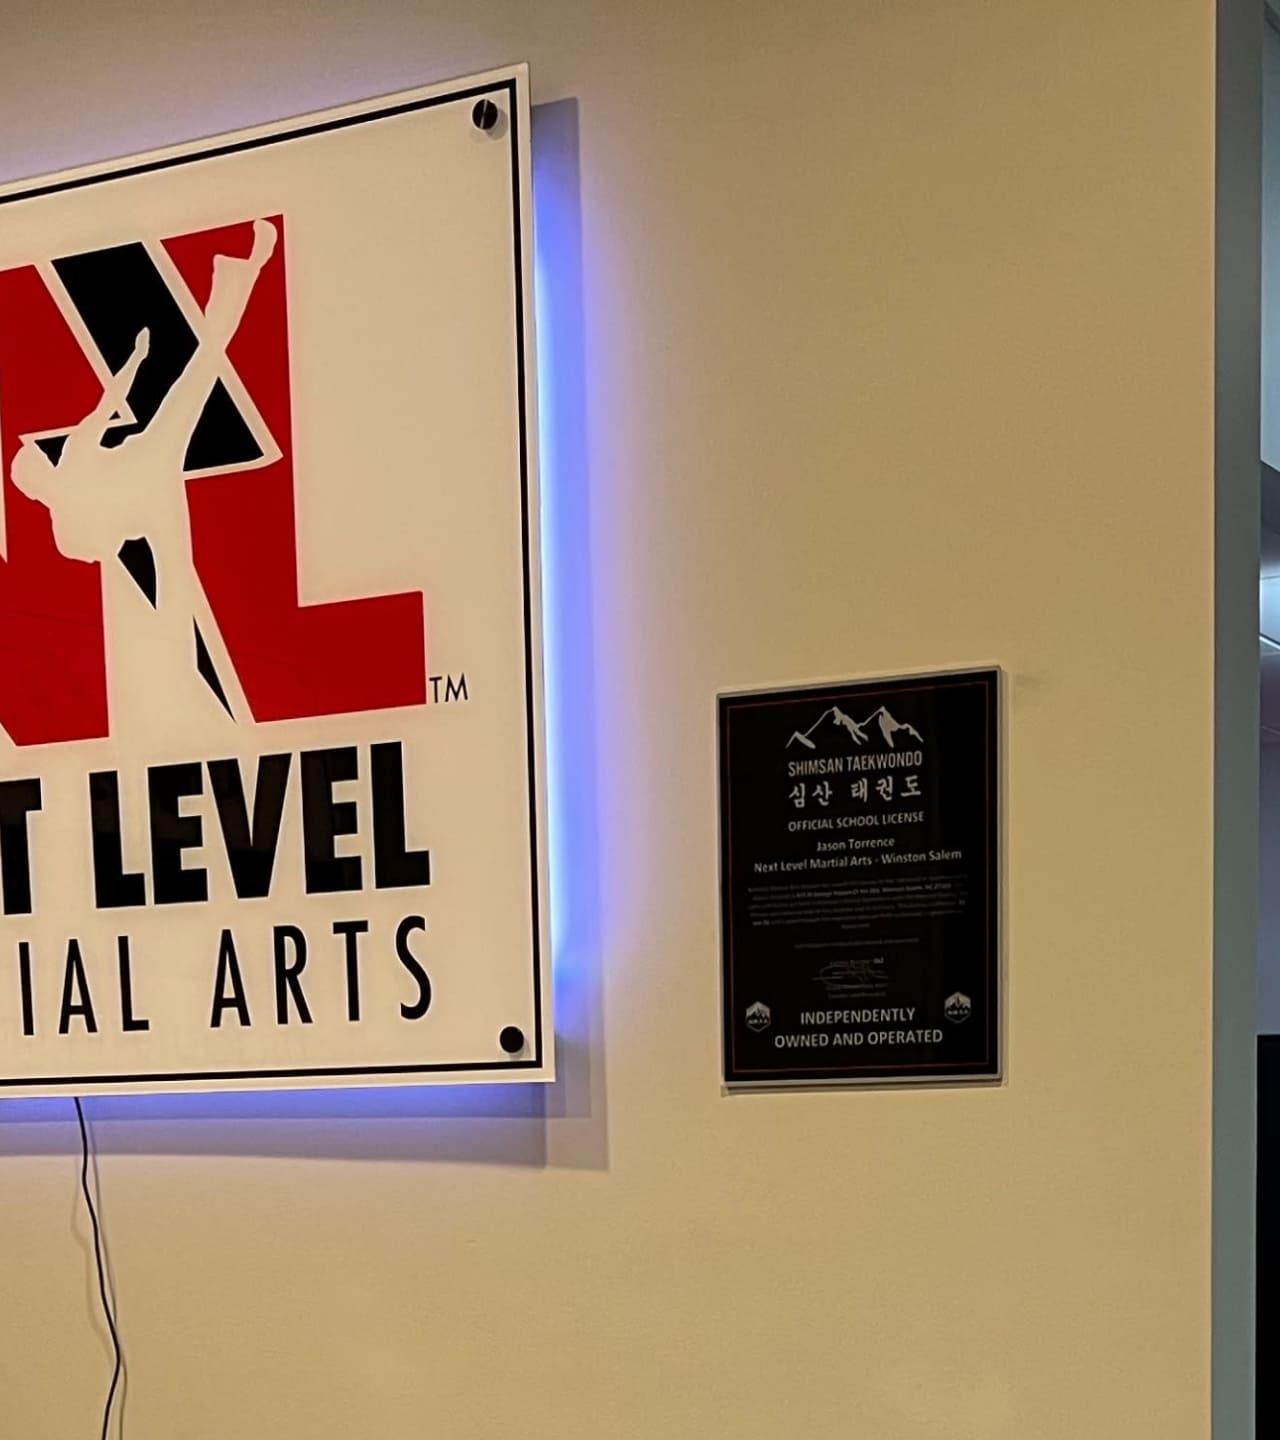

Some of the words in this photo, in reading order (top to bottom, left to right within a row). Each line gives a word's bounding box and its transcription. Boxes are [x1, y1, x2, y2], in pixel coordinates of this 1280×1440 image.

[429, 672, 470, 705] TM
[788, 756, 844, 777] SHIMSAN
[846, 750, 923, 773] TAEKWONDO
[788, 781, 833, 808] 심산
[850, 774, 922, 803] 태권도
[88, 740, 432, 909] LEVEL
[788, 819, 835, 832] OFFICIAL
[836, 815, 880, 828] SCHOOL
[882, 811, 924, 825] LICENSE
[817, 840, 846, 852] Jason
[848, 837, 895, 850] Torrence
[754, 861, 779, 873] Next
[780, 858, 808, 872] Level
[810, 855, 848, 870] Martial
[850, 854, 872, 867] Arts
[881, 851, 926, 865] Winston
[929, 848, 962, 862] Salem
[210, 914, 433, 1029] ARTS
[800, 1007, 916, 1025] INDEPENDENTLY
[774, 1032, 829, 1048] OWNED
[833, 1031, 864, 1046] AND
[867, 1029, 943, 1045] OPERATED
